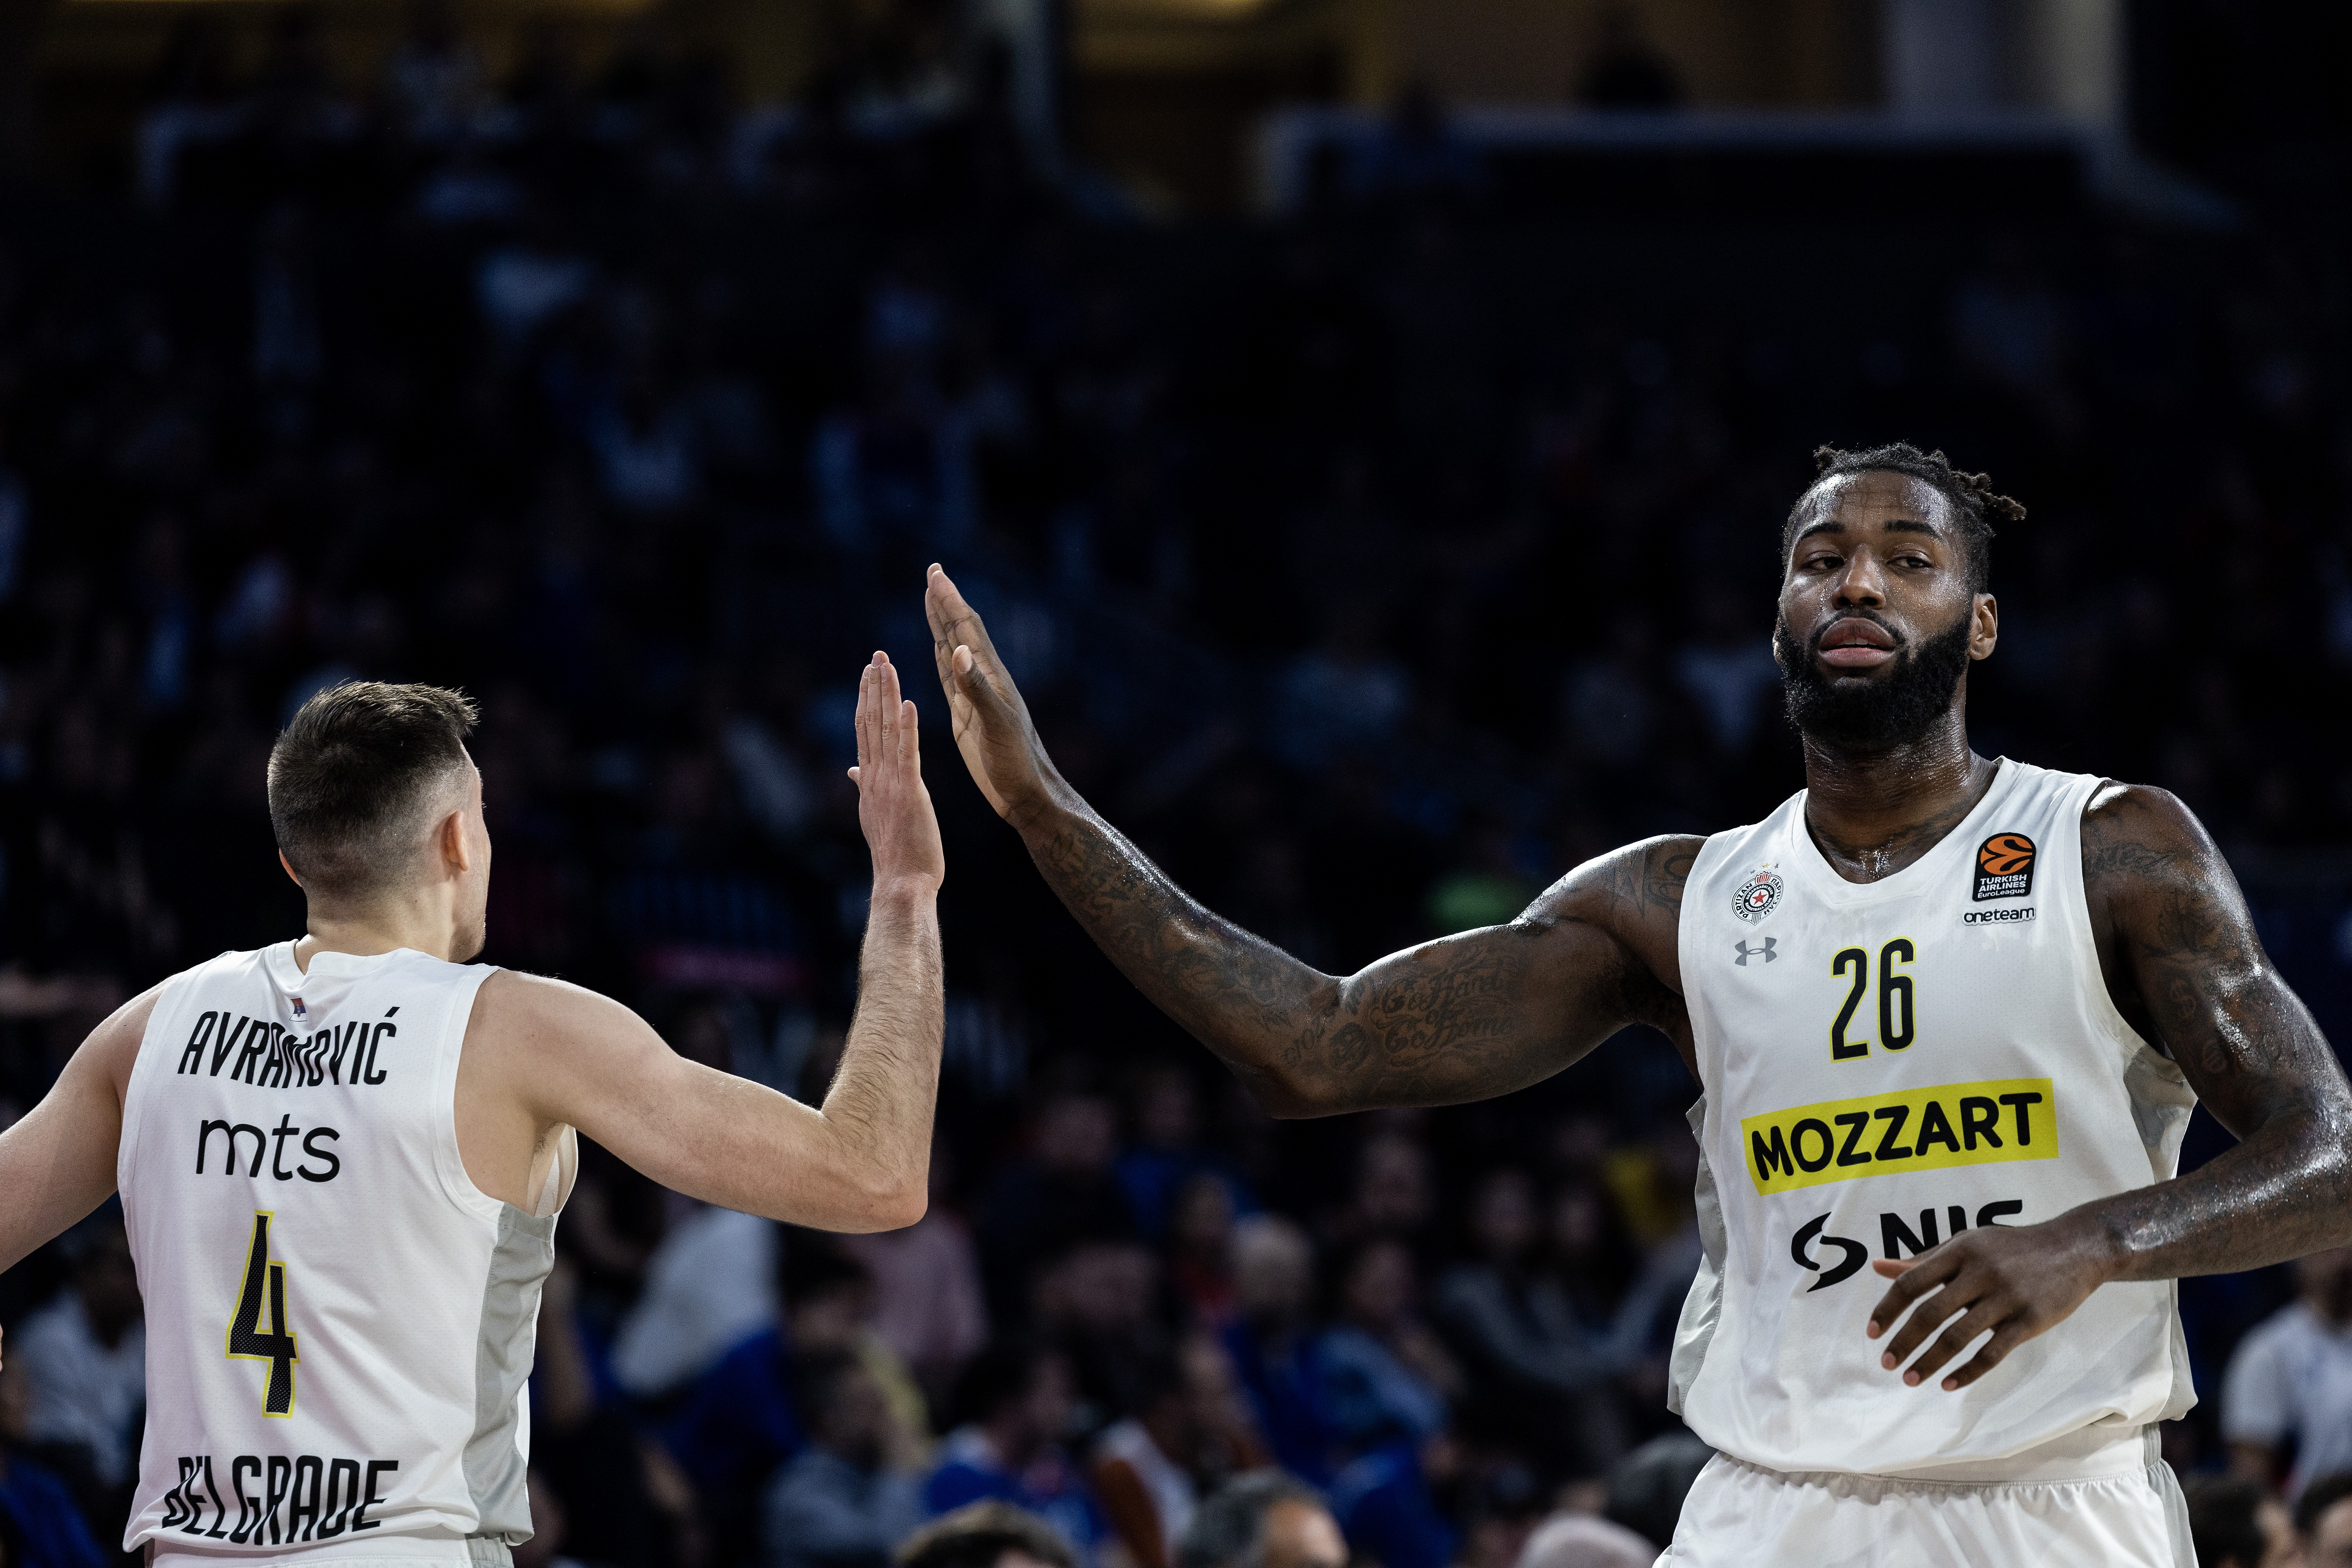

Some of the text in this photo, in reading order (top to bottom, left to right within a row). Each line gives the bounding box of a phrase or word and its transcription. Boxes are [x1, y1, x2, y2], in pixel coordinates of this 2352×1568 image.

[1735, 883, 1752, 918] PARTIZAN
[1964, 907, 2034, 922] oneteam
[1978, 889, 2025, 898] EuroLeague
[1979, 881, 2026, 892] AIRLINES
[1980, 874, 2027, 885] TURKISH
[1831, 936, 1916, 1063] 26
[178, 1007, 400, 1089] AVRAMOVIĆ
[196, 1113, 340, 1183] mts
[1752, 1092, 2042, 1181] MOZZART
[225, 1209, 300, 1419] 4
[162, 1455, 398, 1546] BELGRADE
